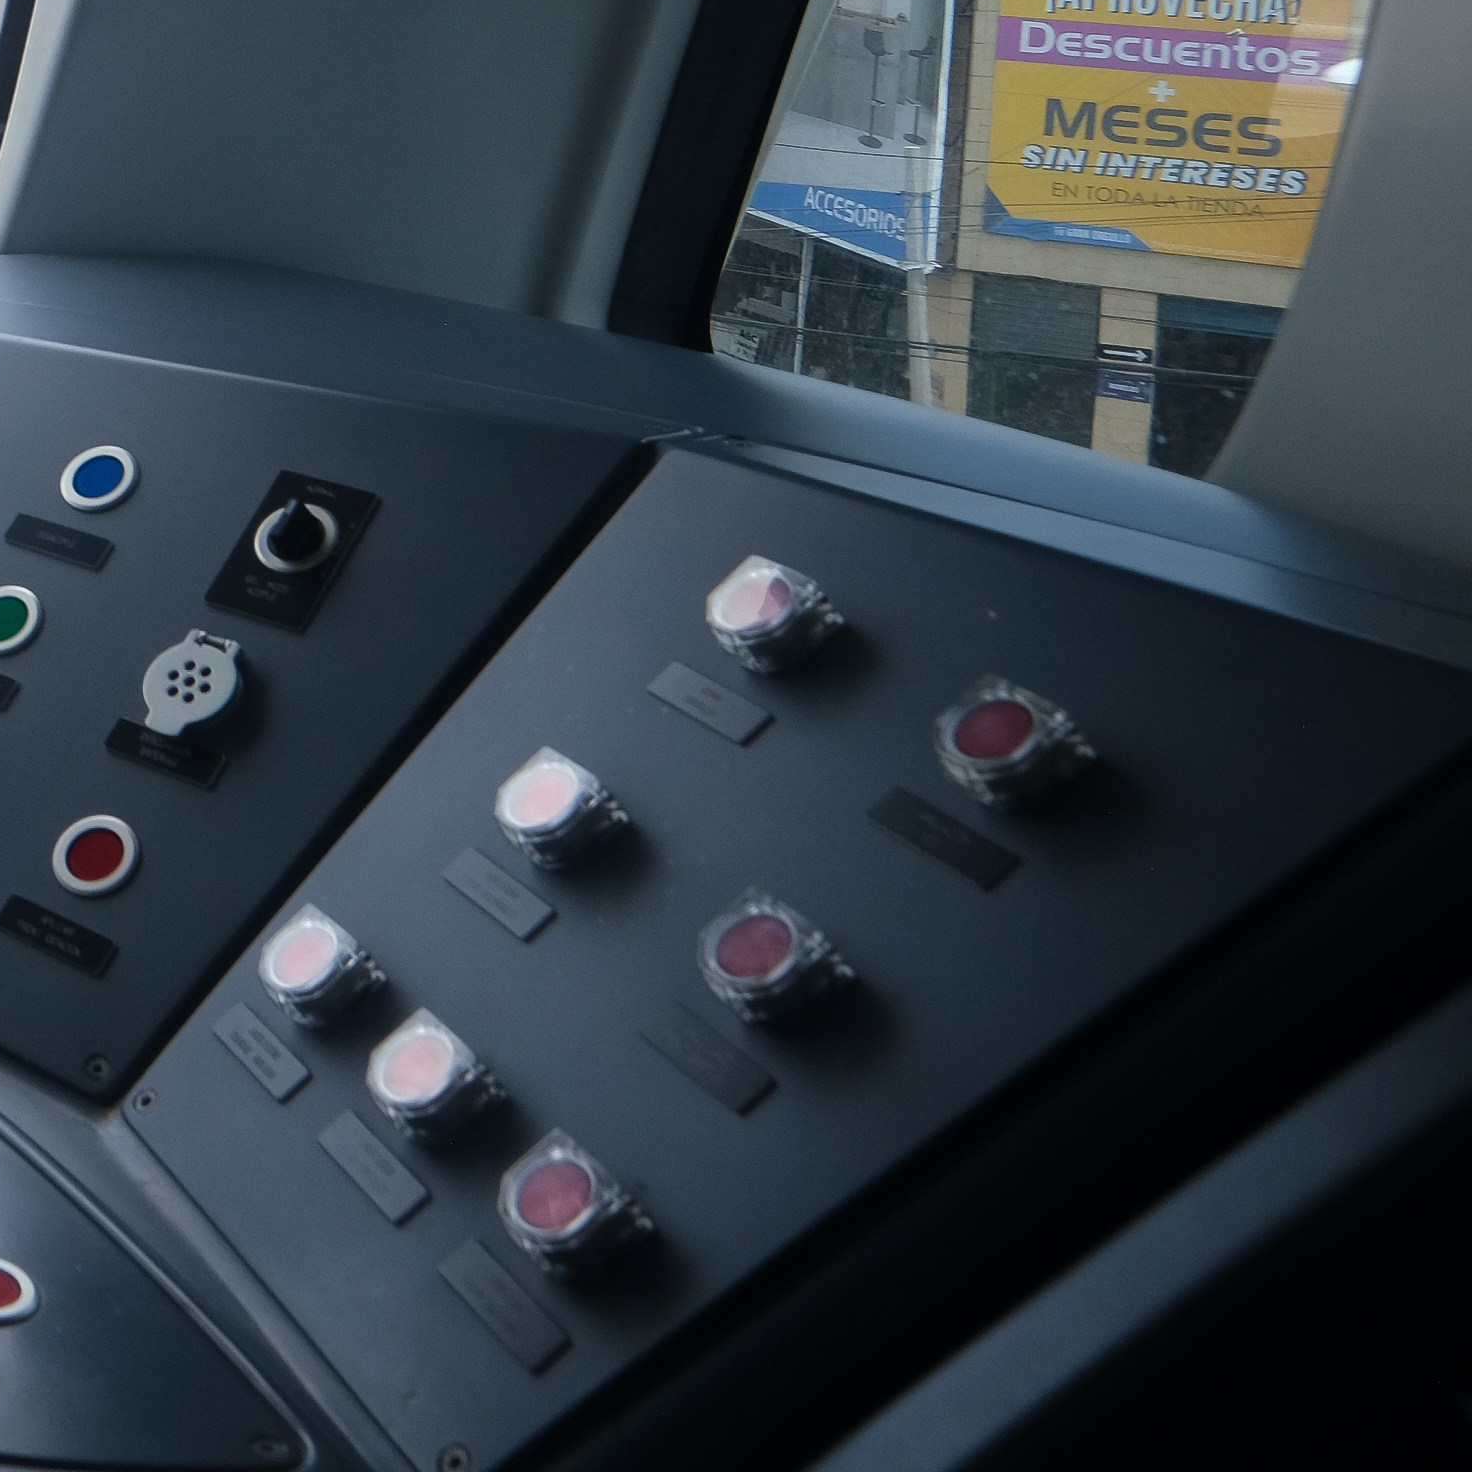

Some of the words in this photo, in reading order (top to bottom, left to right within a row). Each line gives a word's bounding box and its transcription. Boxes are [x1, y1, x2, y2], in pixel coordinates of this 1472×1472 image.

[1020, 20, 1322, 78] Descuentos
[1043, 98, 1282, 158] MESES
[1020, 143, 1088, 174] SIN
[1093, 150, 1309, 197] INTERESES
[803, 185, 906, 242] ACCESORIOS
[1051, 181, 1078, 199] EN
[1085, 185, 1145, 205] TODA
[1153, 193, 1180, 210] LA
[1186, 195, 1266, 219] TIENDA
